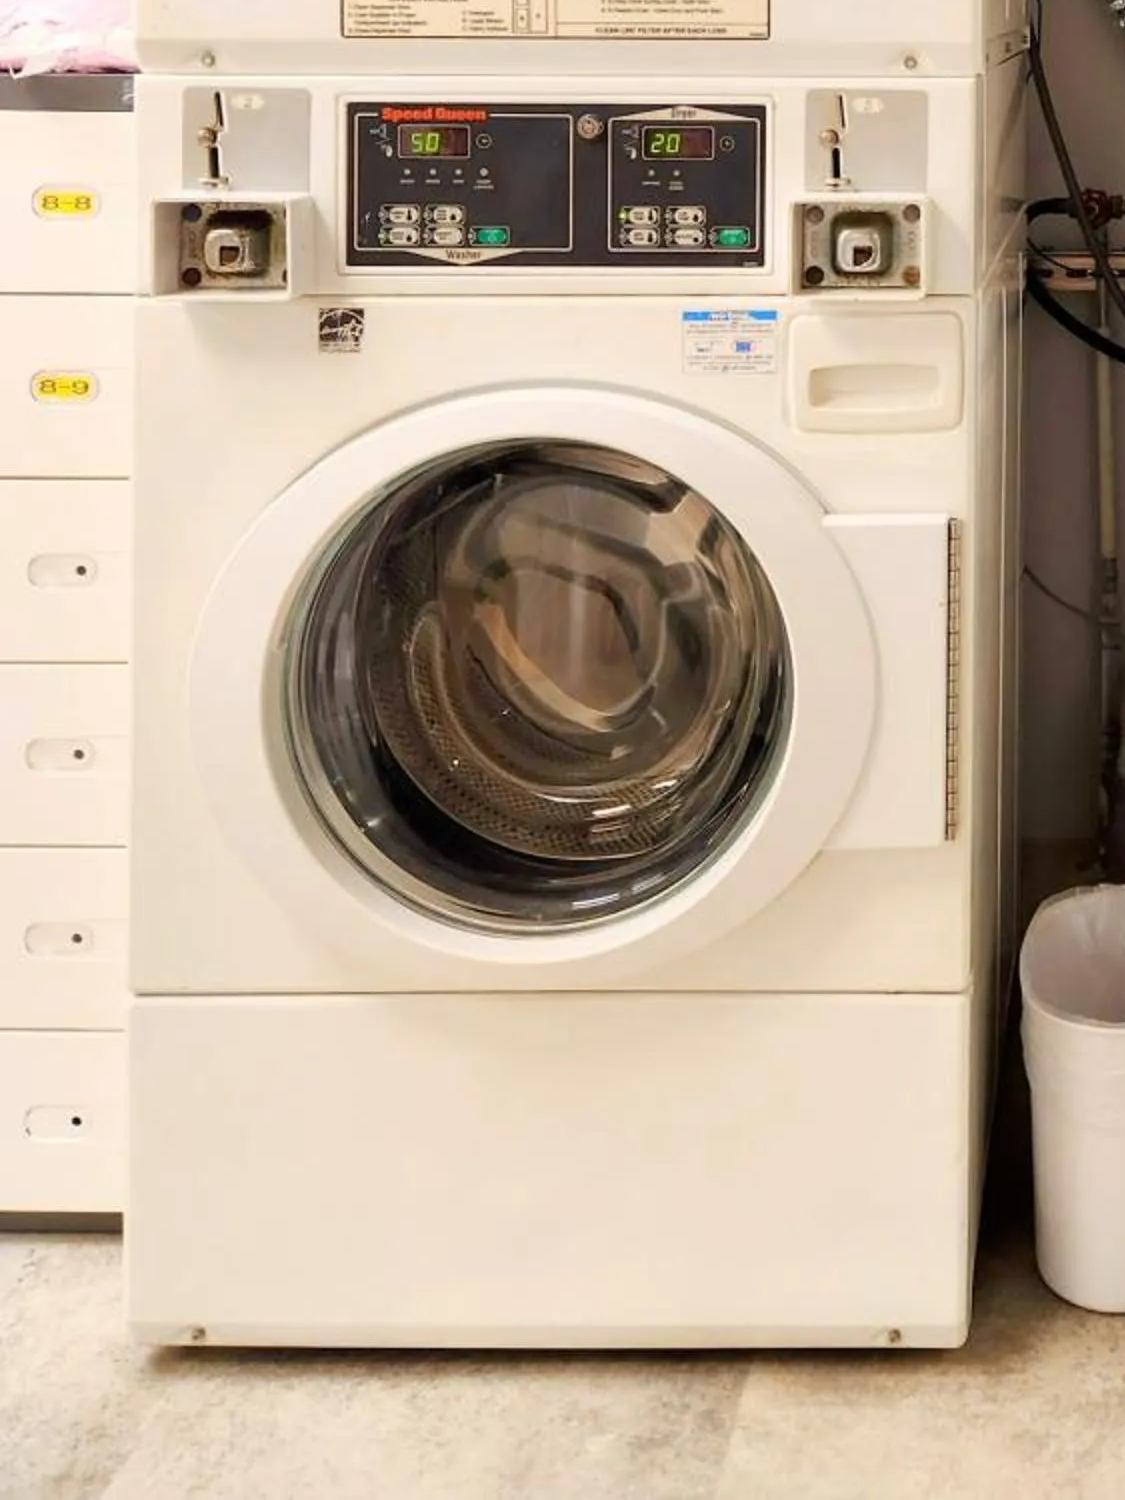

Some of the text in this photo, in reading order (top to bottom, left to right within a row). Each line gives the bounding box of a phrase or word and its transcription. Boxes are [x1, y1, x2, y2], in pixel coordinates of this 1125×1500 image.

[382, 107, 486, 122] Speed Queen
[671, 107, 697, 119] Dryer
[411, 132, 440, 153] 50
[650, 133, 681, 153] 20
[41, 195, 92, 211] 8-8
[446, 250, 483, 260] Washer
[39, 379, 90, 395] 8-9
